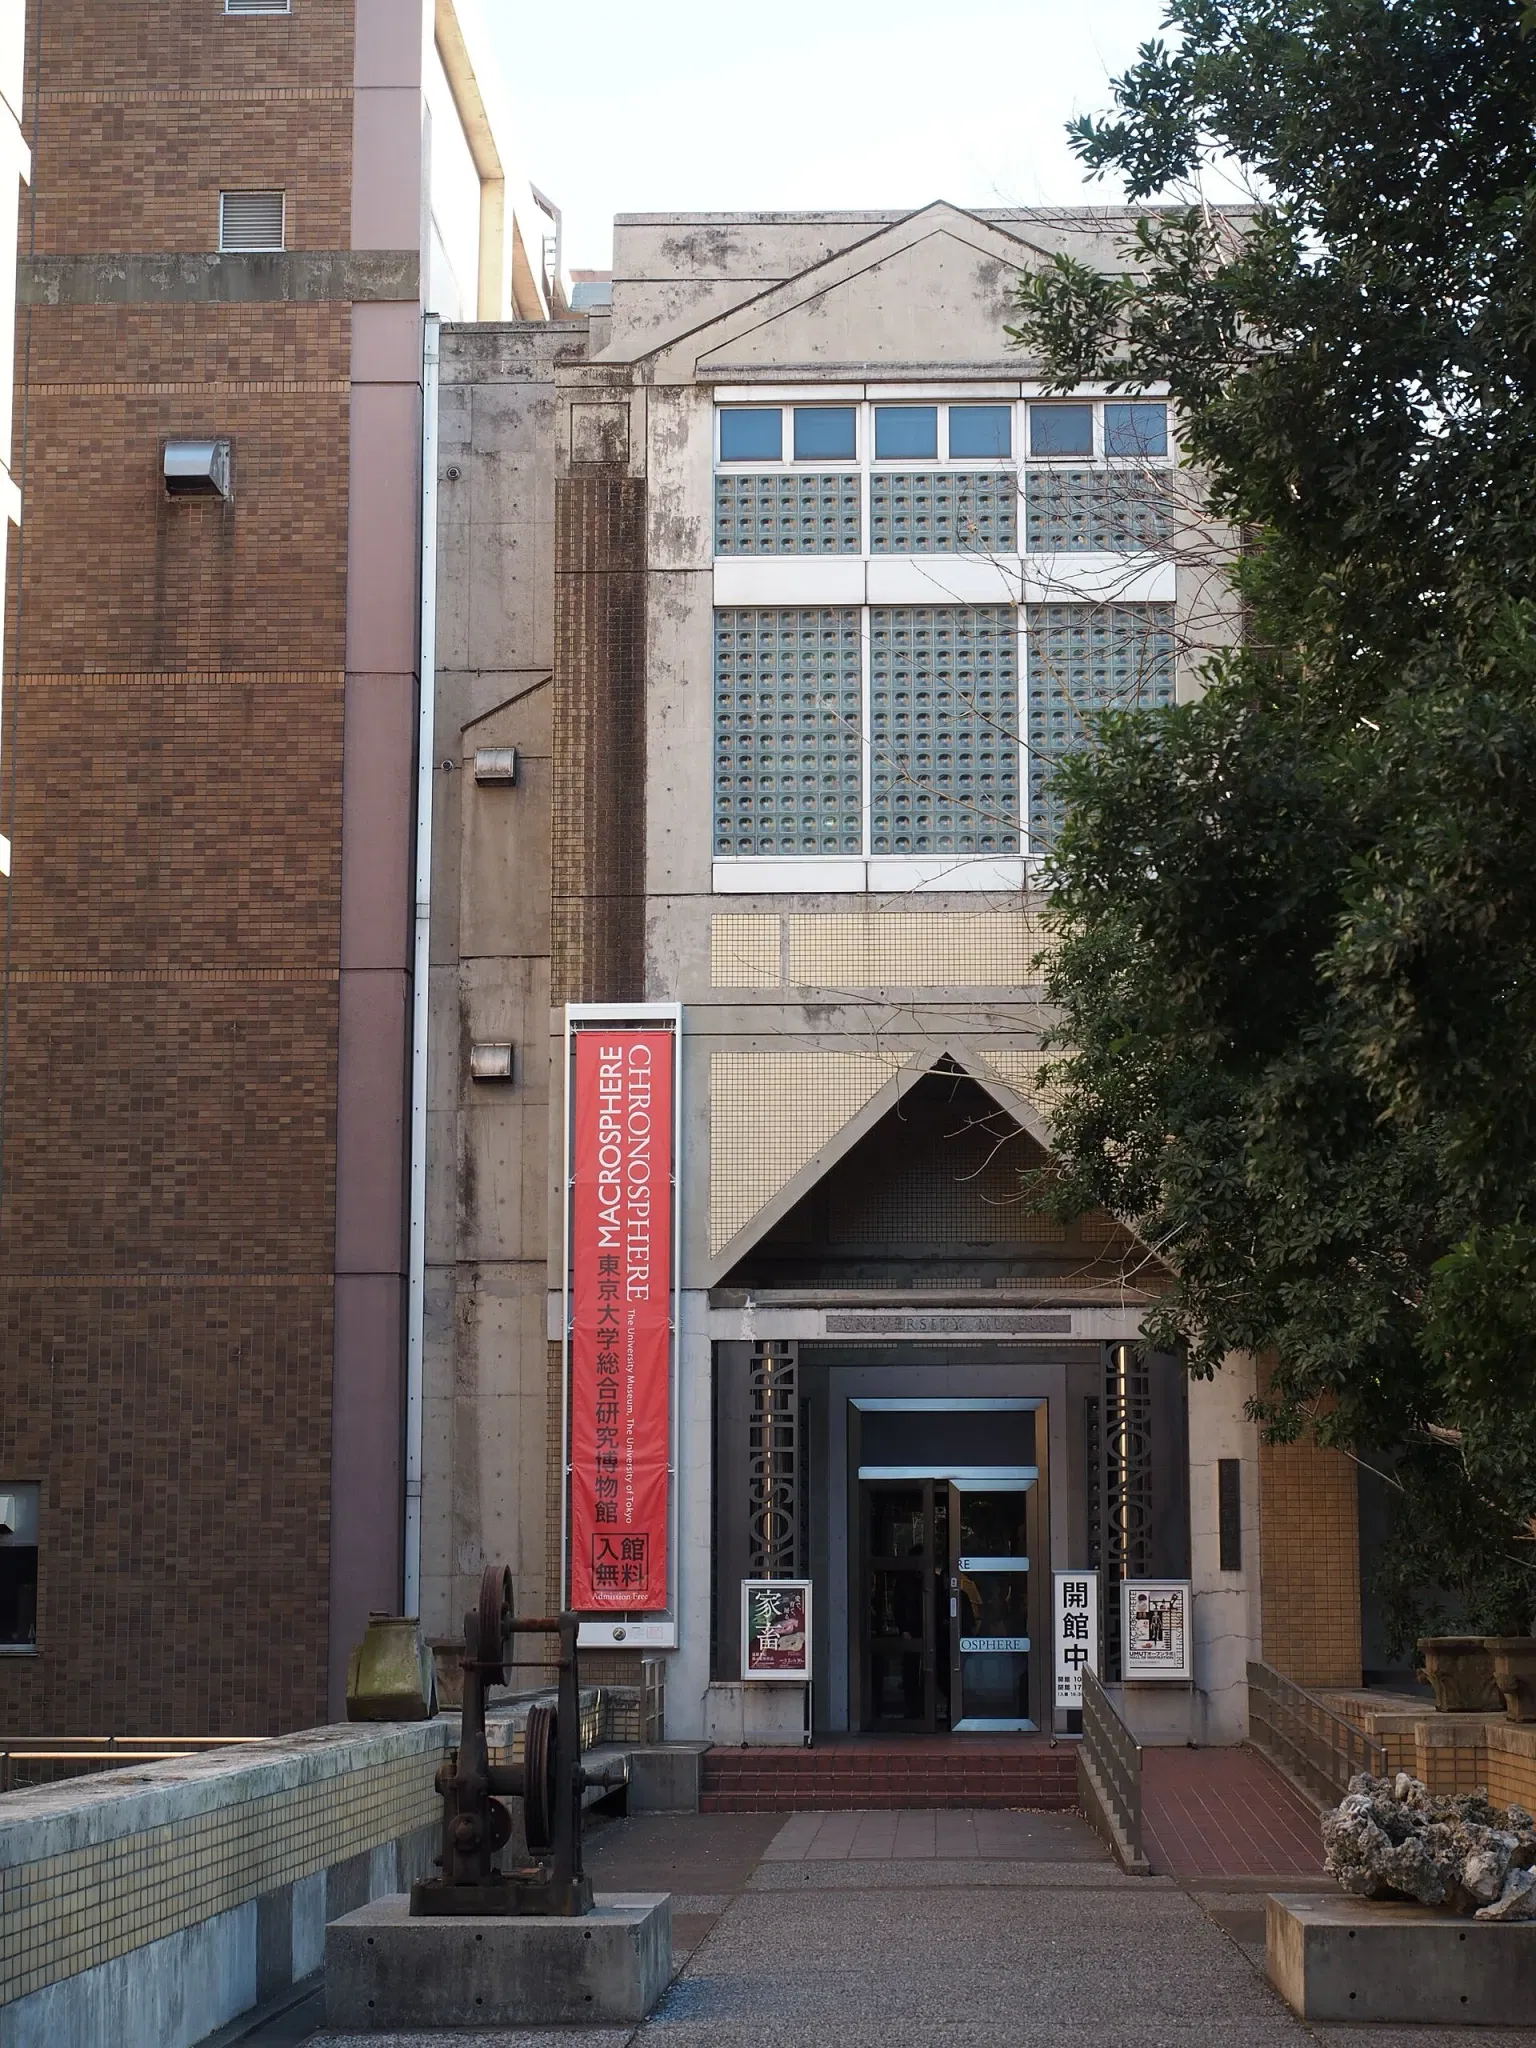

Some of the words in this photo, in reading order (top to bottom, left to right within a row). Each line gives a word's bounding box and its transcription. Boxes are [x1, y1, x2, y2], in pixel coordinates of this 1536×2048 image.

[598, 1046, 623, 1248] MACROSPHERE
[626, 1044, 652, 1302] CHRONOSPHERE
[626, 1309, 636, 1326] The
[843, 1317, 962, 1331] UNIVERSITY
[978, 1317, 1056, 1331] MUSEUM
[624, 1327, 636, 1373] University
[595, 1253, 621, 1524] 東京大学総合研究博物館
[625, 1375, 636, 1416] Museum,
[625, 1418, 635, 1435] The
[623, 1437, 635, 1484] University
[750, 1342, 793, 1579] ROSPHERE
[624, 1485, 634, 1496] of
[623, 1496, 635, 1524] Tokyo
[597, 1537, 645, 1562] 入館
[595, 1562, 645, 1588] 無料
[592, 1592, 631, 1601] Admission
[632, 1592, 649, 1601] Free
[752, 1589, 782, 1651] 家畜
[1062, 1581, 1089, 1672] 開館中
[961, 1639, 1021, 1651] OSPHERE
